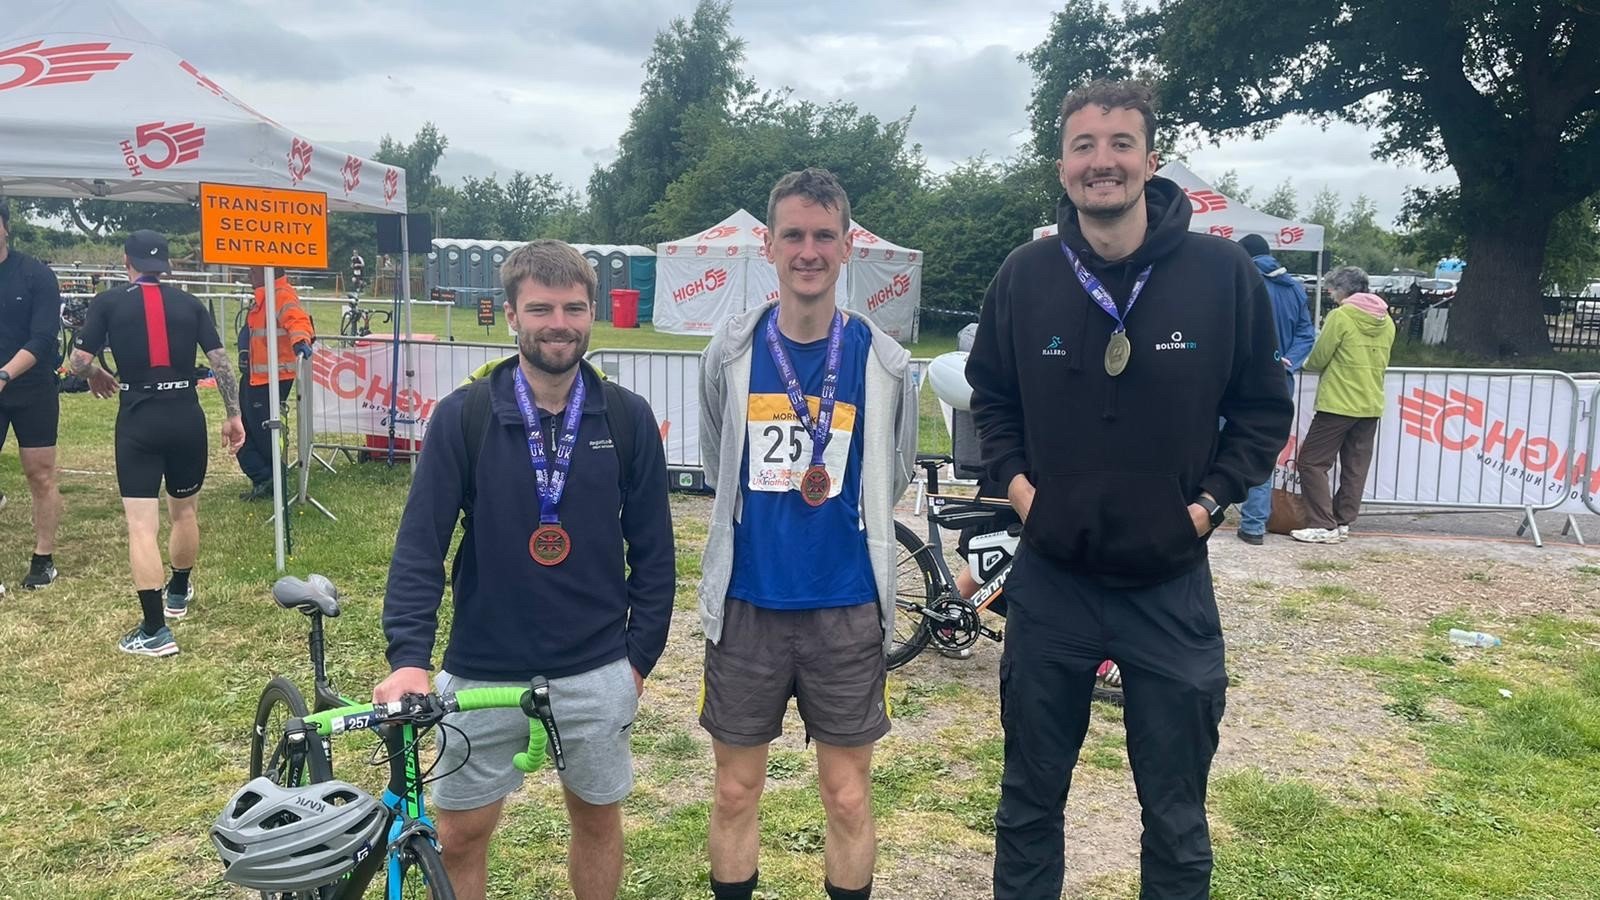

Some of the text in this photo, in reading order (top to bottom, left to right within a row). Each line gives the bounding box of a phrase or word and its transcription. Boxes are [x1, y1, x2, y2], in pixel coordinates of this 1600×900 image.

[206, 195, 322, 216] TRANSITION
[220, 217, 312, 235] SECURITY
[216, 238, 317, 256] ENTRANCE
[530, 448, 545, 457] UK
[557, 448, 572, 459] UK
[348, 716, 370, 730] 257
